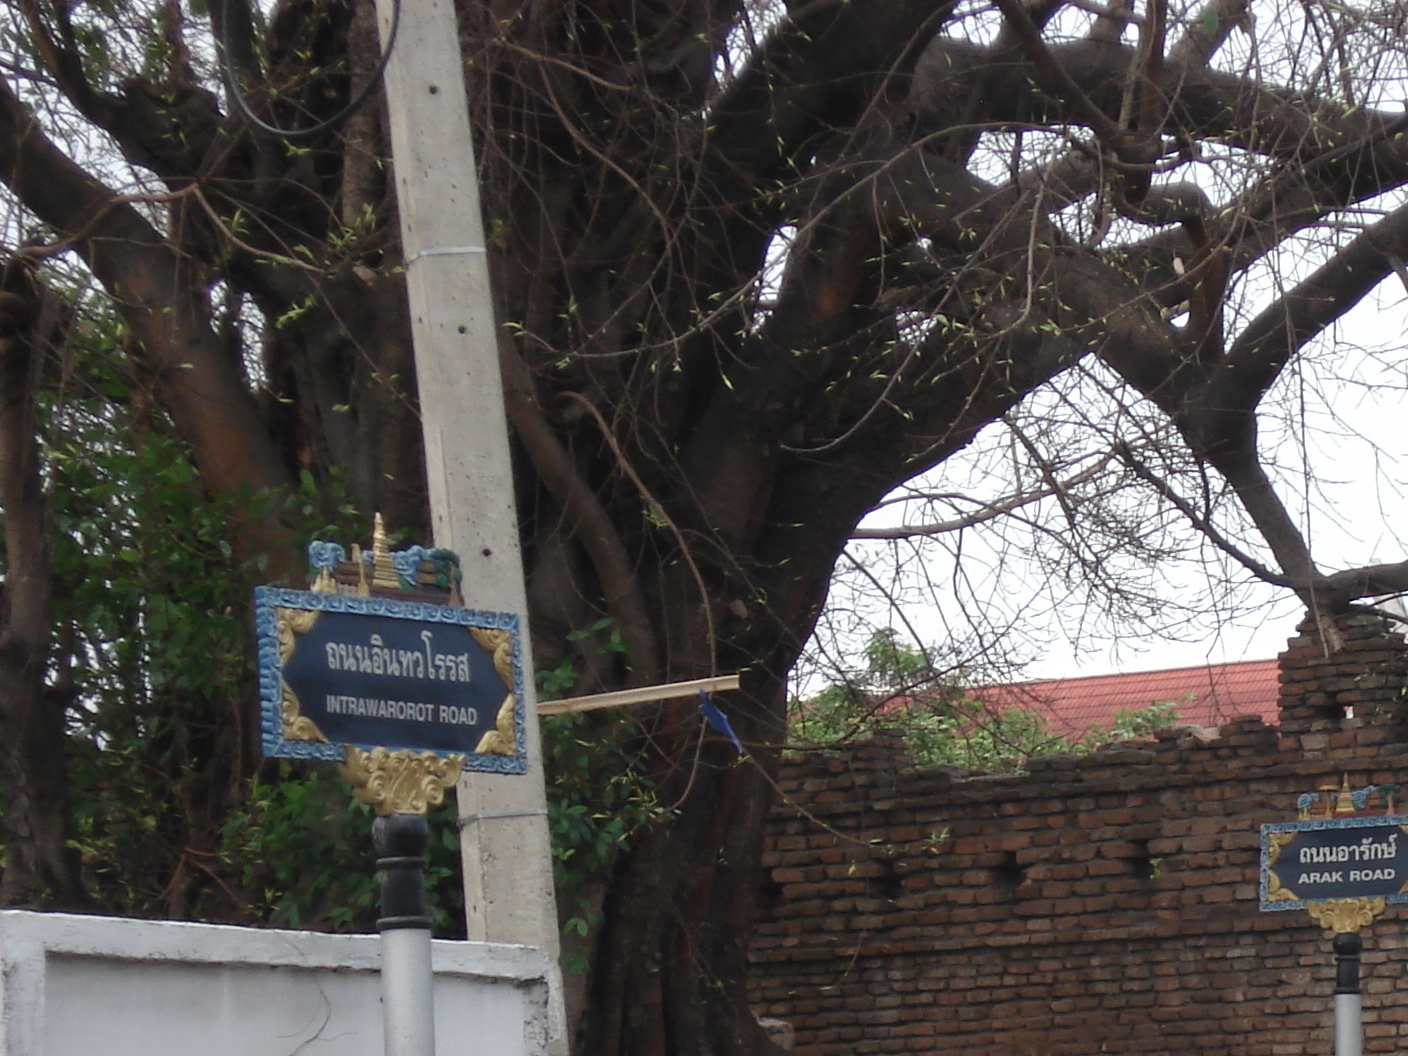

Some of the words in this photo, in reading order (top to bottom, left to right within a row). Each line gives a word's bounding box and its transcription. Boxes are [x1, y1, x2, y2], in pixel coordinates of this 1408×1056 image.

[326, 630, 470, 682] ถนนอินทวโรรส
[326, 694, 434, 722] INTRAWAROROT
[439, 705, 477, 725] ROAD
[1300, 834, 1398, 863] ถนนอารักษ์
[1298, 871, 1344, 884] ARAK
[1349, 868, 1396, 882] ROAD
